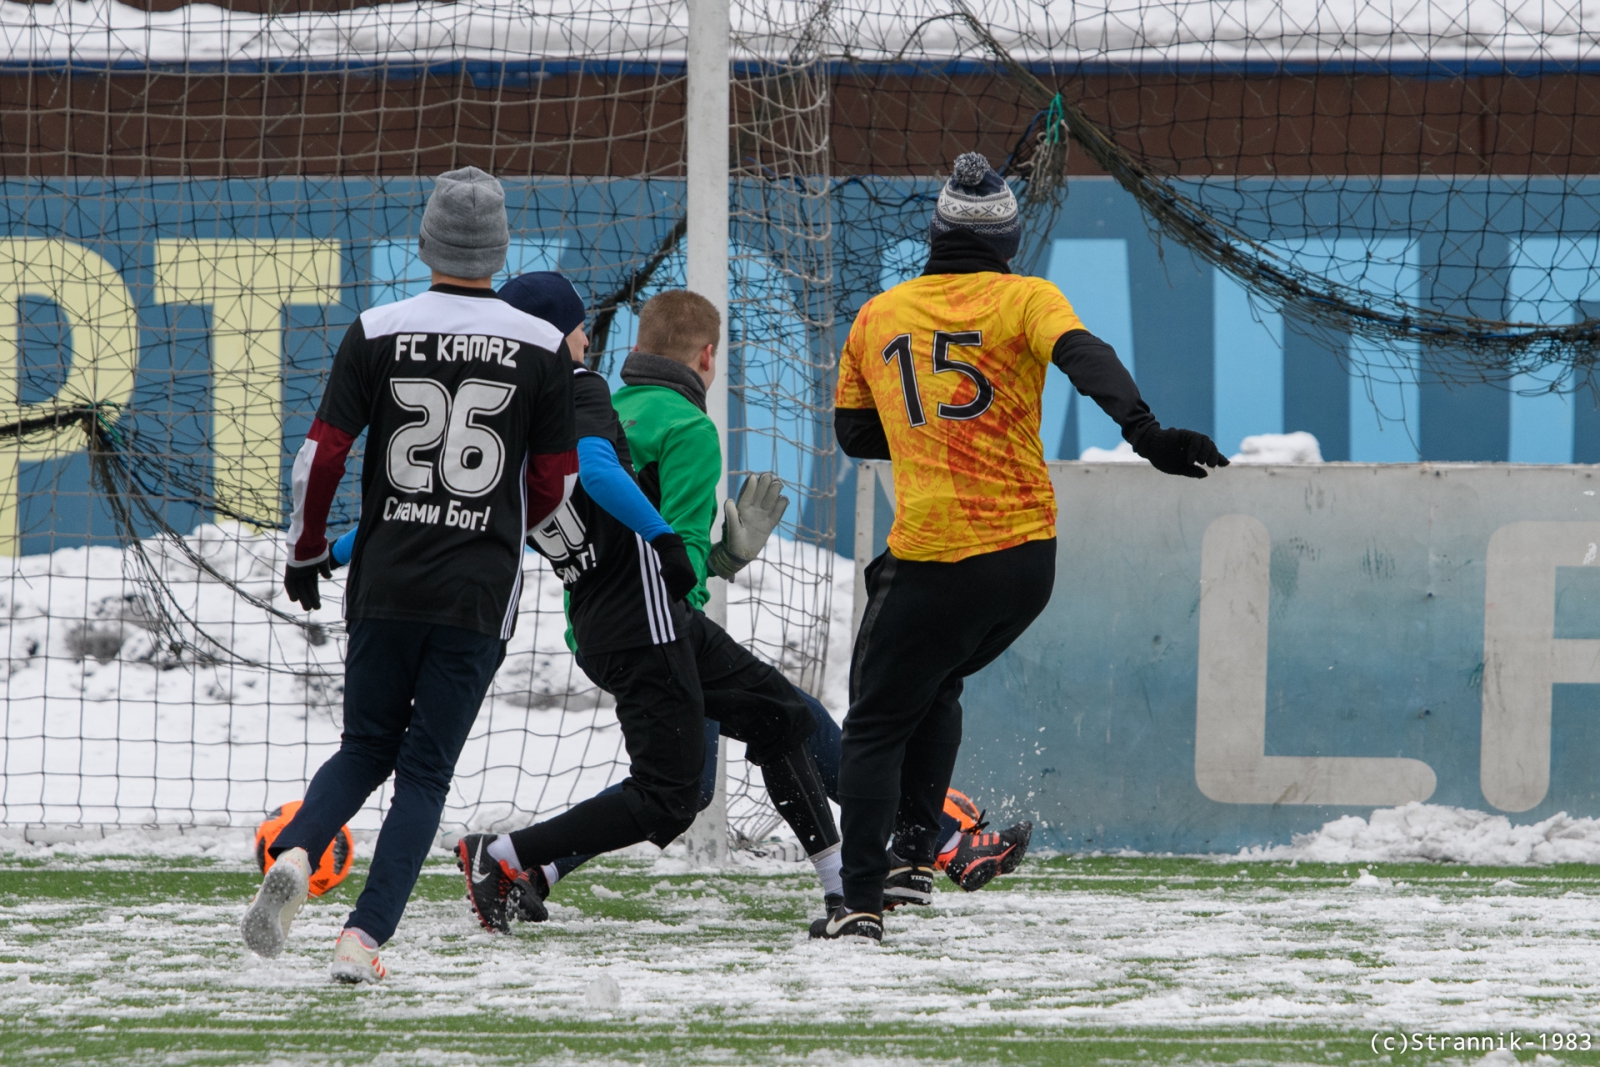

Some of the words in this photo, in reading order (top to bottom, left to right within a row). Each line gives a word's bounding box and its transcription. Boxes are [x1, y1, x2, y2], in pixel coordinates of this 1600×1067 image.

[395, 334, 428, 361] FC
[436, 334, 521, 368] KAMAZ
[881, 330, 995, 428] 15
[386, 377, 517, 498] 26
[445, 499, 491, 532] Бог!
